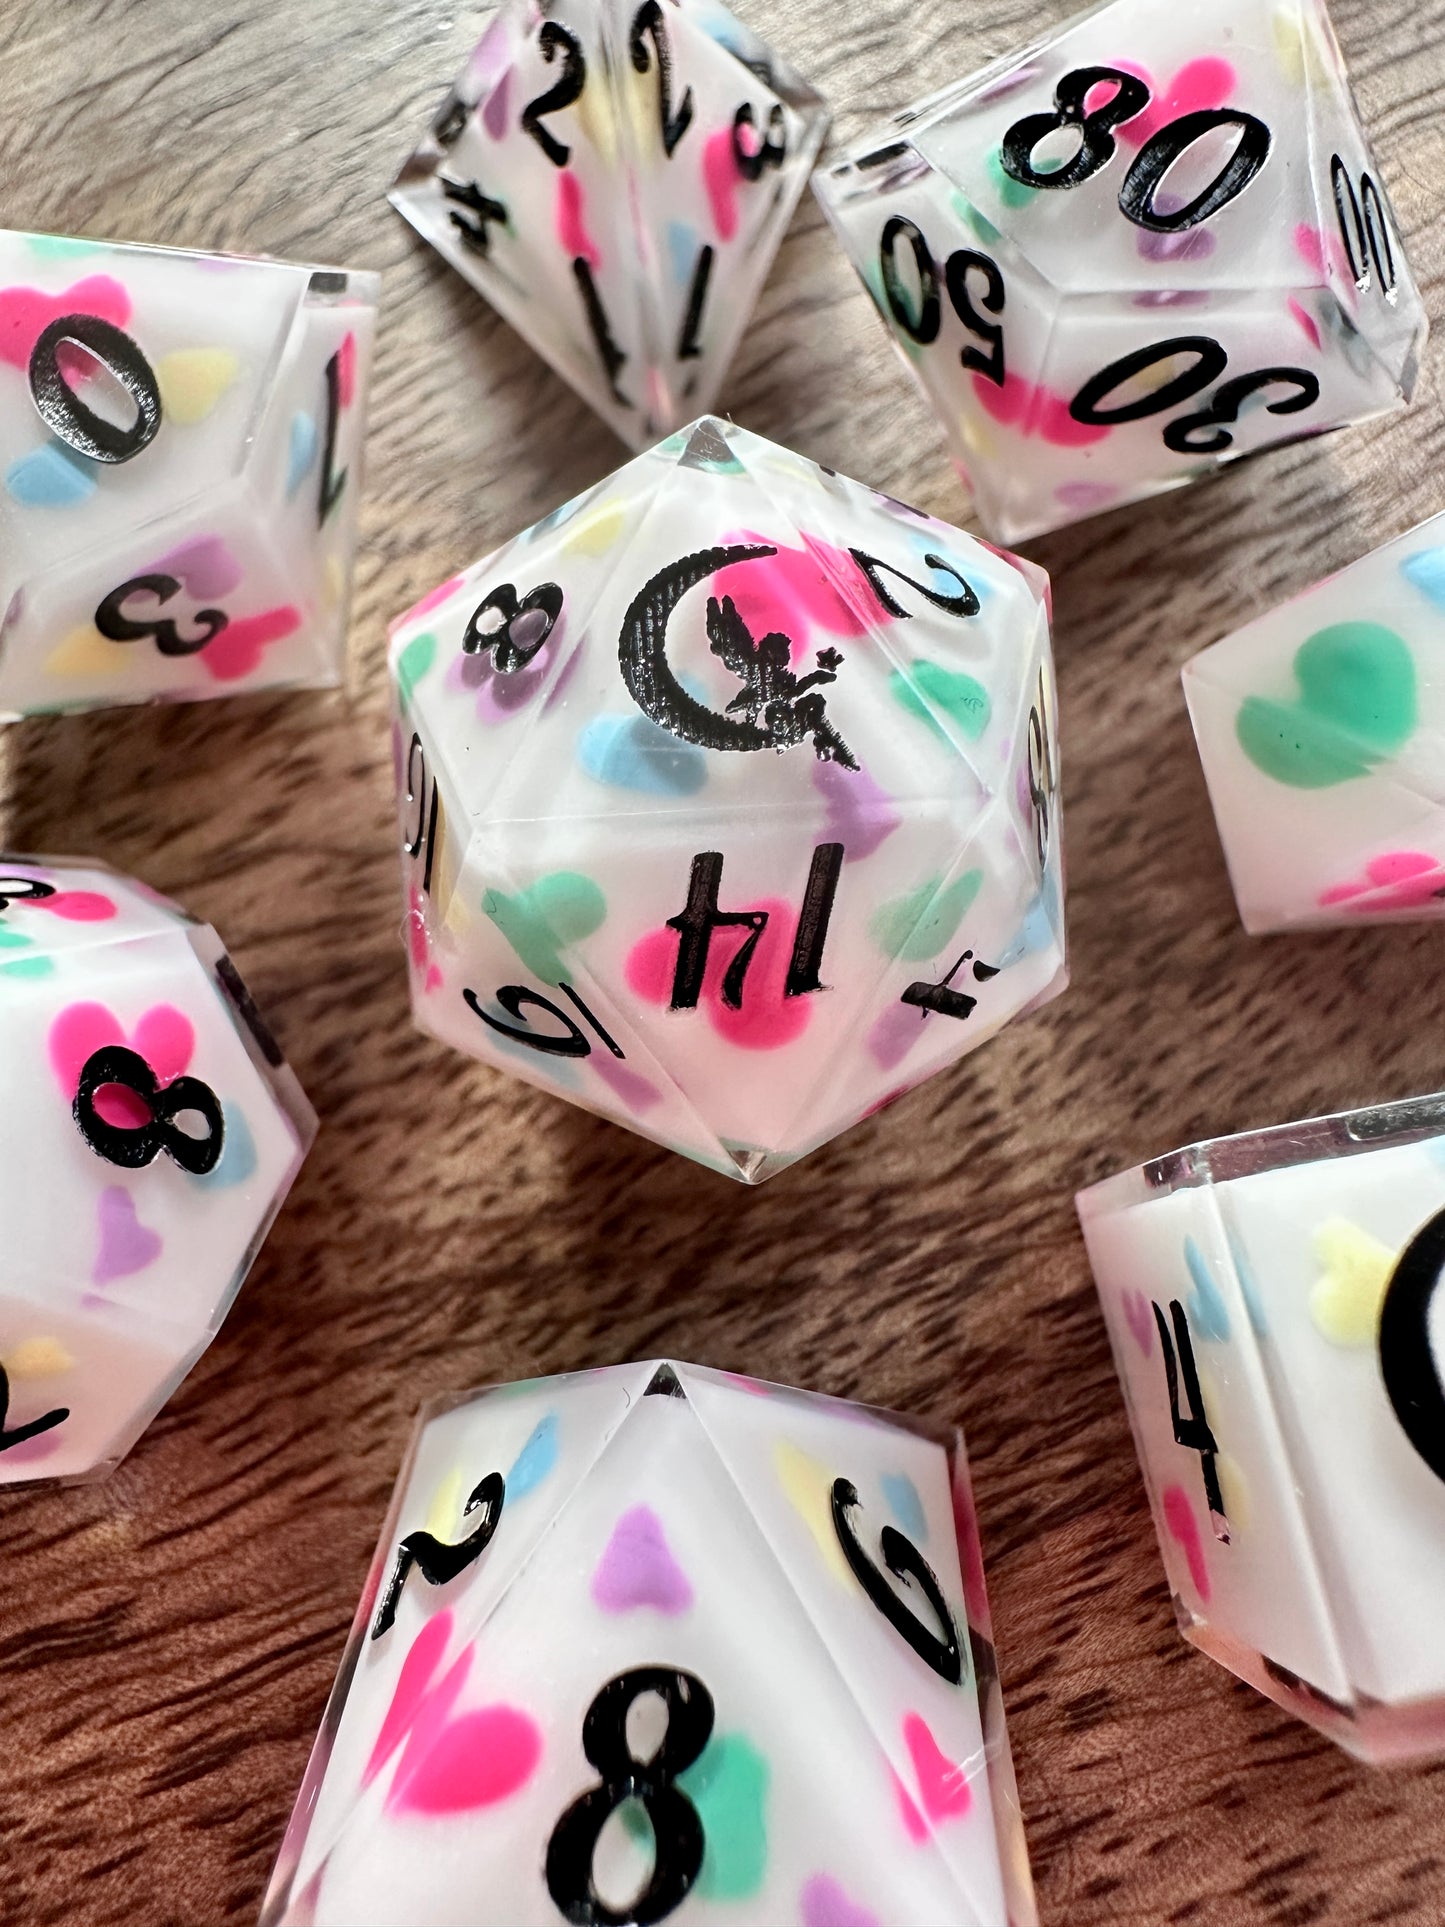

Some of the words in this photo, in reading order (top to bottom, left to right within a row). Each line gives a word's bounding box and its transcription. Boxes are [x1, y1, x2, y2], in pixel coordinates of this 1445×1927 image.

[522, 21, 587, 167] 2
[999, 65, 1273, 233] 80
[880, 214, 1006, 388] 50
[28, 313, 162, 464] 0
[1069, 335, 1320, 454] 30
[95, 573, 229, 658] 3
[461, 582, 564, 675] 8
[847, 547, 980, 618] 2
[666, 842, 844, 1012] 14
[73, 1045, 225, 1175] 8
[1151, 1298, 1230, 1545] 4
[370, 1471, 505, 1641] 2
[831, 1477, 962, 1687] 6
[545, 1664, 715, 1927] 8
